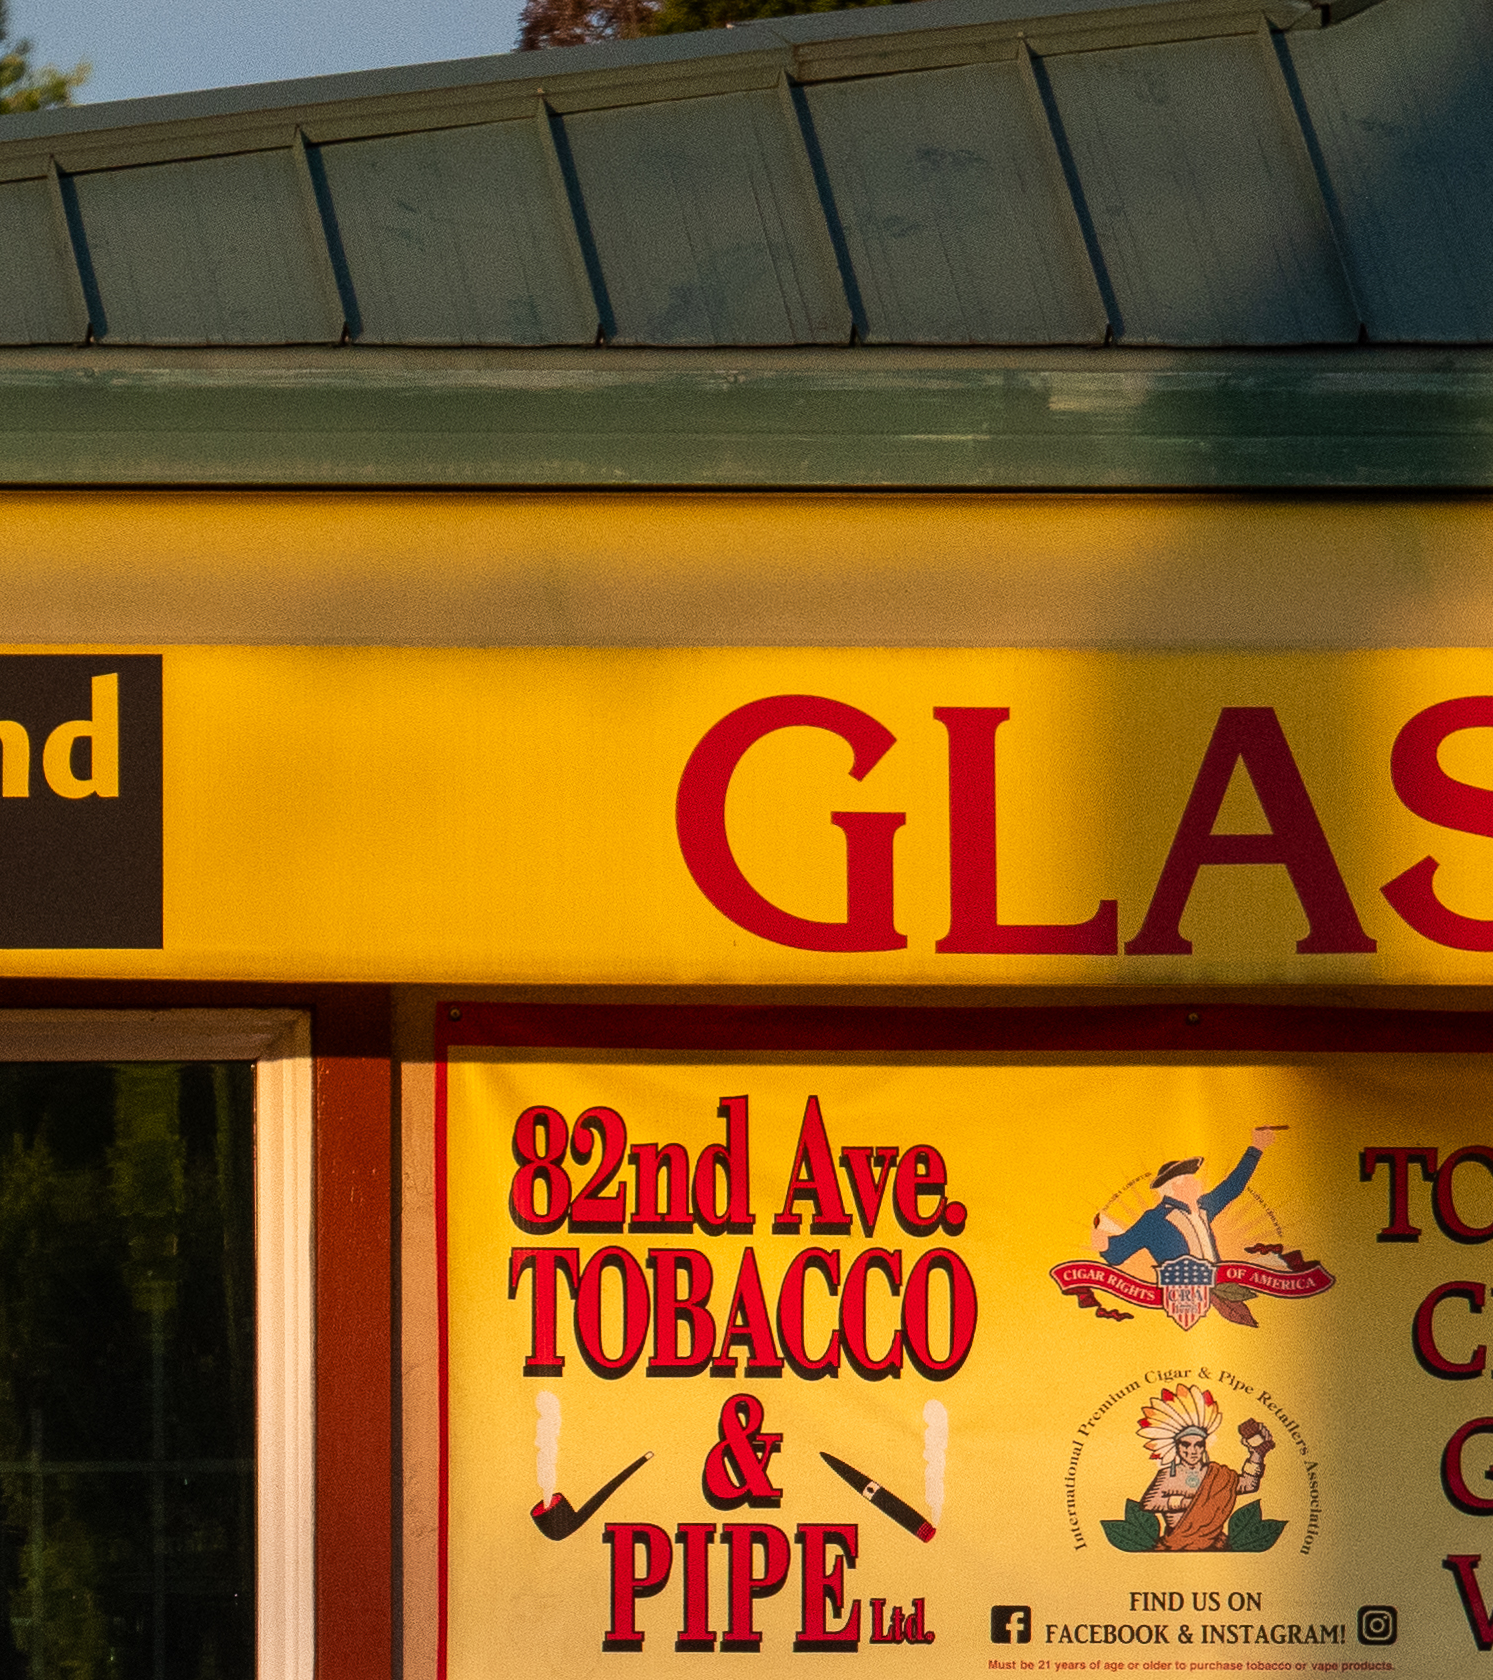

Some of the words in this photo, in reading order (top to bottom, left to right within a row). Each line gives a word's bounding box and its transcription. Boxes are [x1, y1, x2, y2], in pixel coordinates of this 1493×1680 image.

[508, 1094, 756, 1236] 82nd
[772, 1094, 968, 1238] Ave.
[508, 1244, 978, 1382] TOBACCO
[1063, 1268, 1105, 1282] CIGAR
[1107, 1274, 1156, 1301] RIGHTS
[1226, 1267, 1247, 1280] OF
[1249, 1272, 1316, 1290] AMERICA
[702, 1392, 784, 1511] &
[1065, 1440, 1087, 1551] International
[1077, 1380, 1141, 1437] Premium
[1144, 1368, 1192, 1384] Cigar
[1198, 1366, 1212, 1379] &
[1218, 1370, 1254, 1395] Pipe
[1256, 1390, 1309, 1456] Retailers
[1299, 1460, 1323, 1555] Association
[601, 1521, 862, 1653] PIPE
[868, 1597, 936, 1645] Ltd.
[1045, 1624, 1170, 1644] FACEBOOK
[1177, 1624, 1194, 1644] &
[1201, 1624, 1346, 1645] INSTAGRAM!
[1129, 1592, 1185, 1612] FIND
[1191, 1592, 1221, 1611] US
[1227, 1592, 1263, 1612] ON
[988, 1660, 1016, 1670] Must
[1020, 1660, 1034, 1670] be
[1038, 1660, 1051, 1670] 21
[1055, 1662, 1086, 1672] years
[1089, 1660, 1101, 1670] of
[1104, 1662, 1124, 1672] age
[1127, 1662, 1140, 1670] or
[1143, 1660, 1172, 1670] older
[1175, 1661, 1186, 1670] to
[1190, 1661, 1243, 1672] purchase
[1246, 1661, 1291, 1671] tobacco
[1295, 1662, 1307, 1671] or
[1311, 1662, 1338, 1672] vape
[1341, 1661, 1395, 1672] products.
